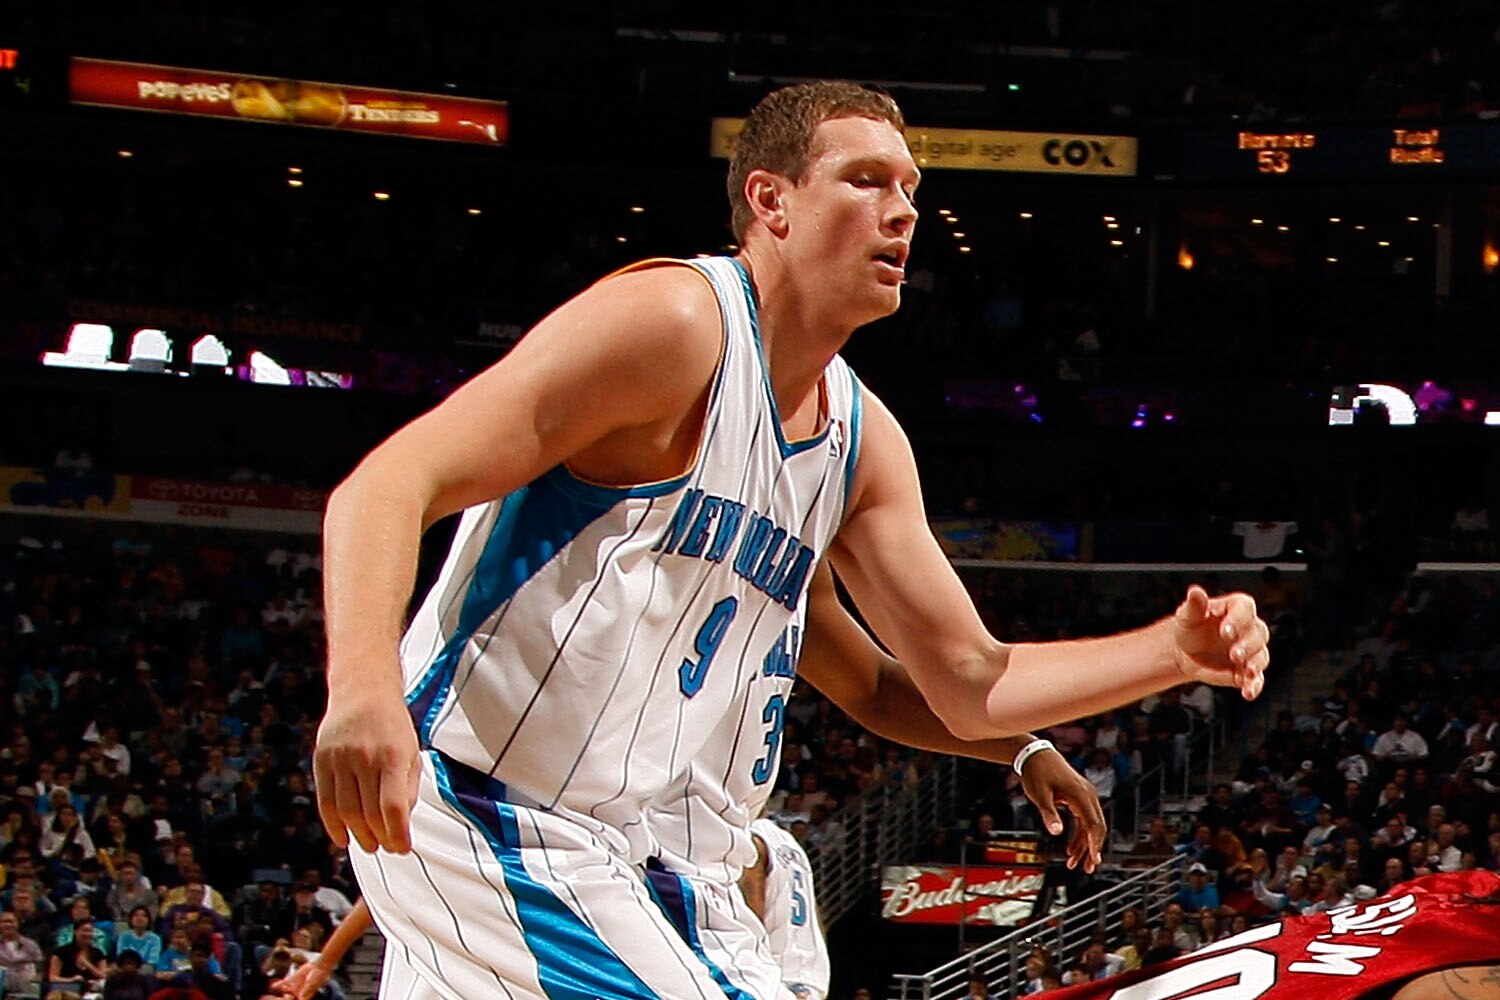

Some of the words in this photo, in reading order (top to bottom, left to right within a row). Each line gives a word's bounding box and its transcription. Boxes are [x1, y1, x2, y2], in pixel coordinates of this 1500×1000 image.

[1043, 138, 1116, 168] COX
[1257, 150, 1291, 174] 53
[180, 482, 260, 504] TOYOTA
[178, 502, 228, 519] ZONE
[652, 488, 745, 563] NEW
[734, 511, 815, 612] ORLEA
[678, 595, 738, 699] 9
